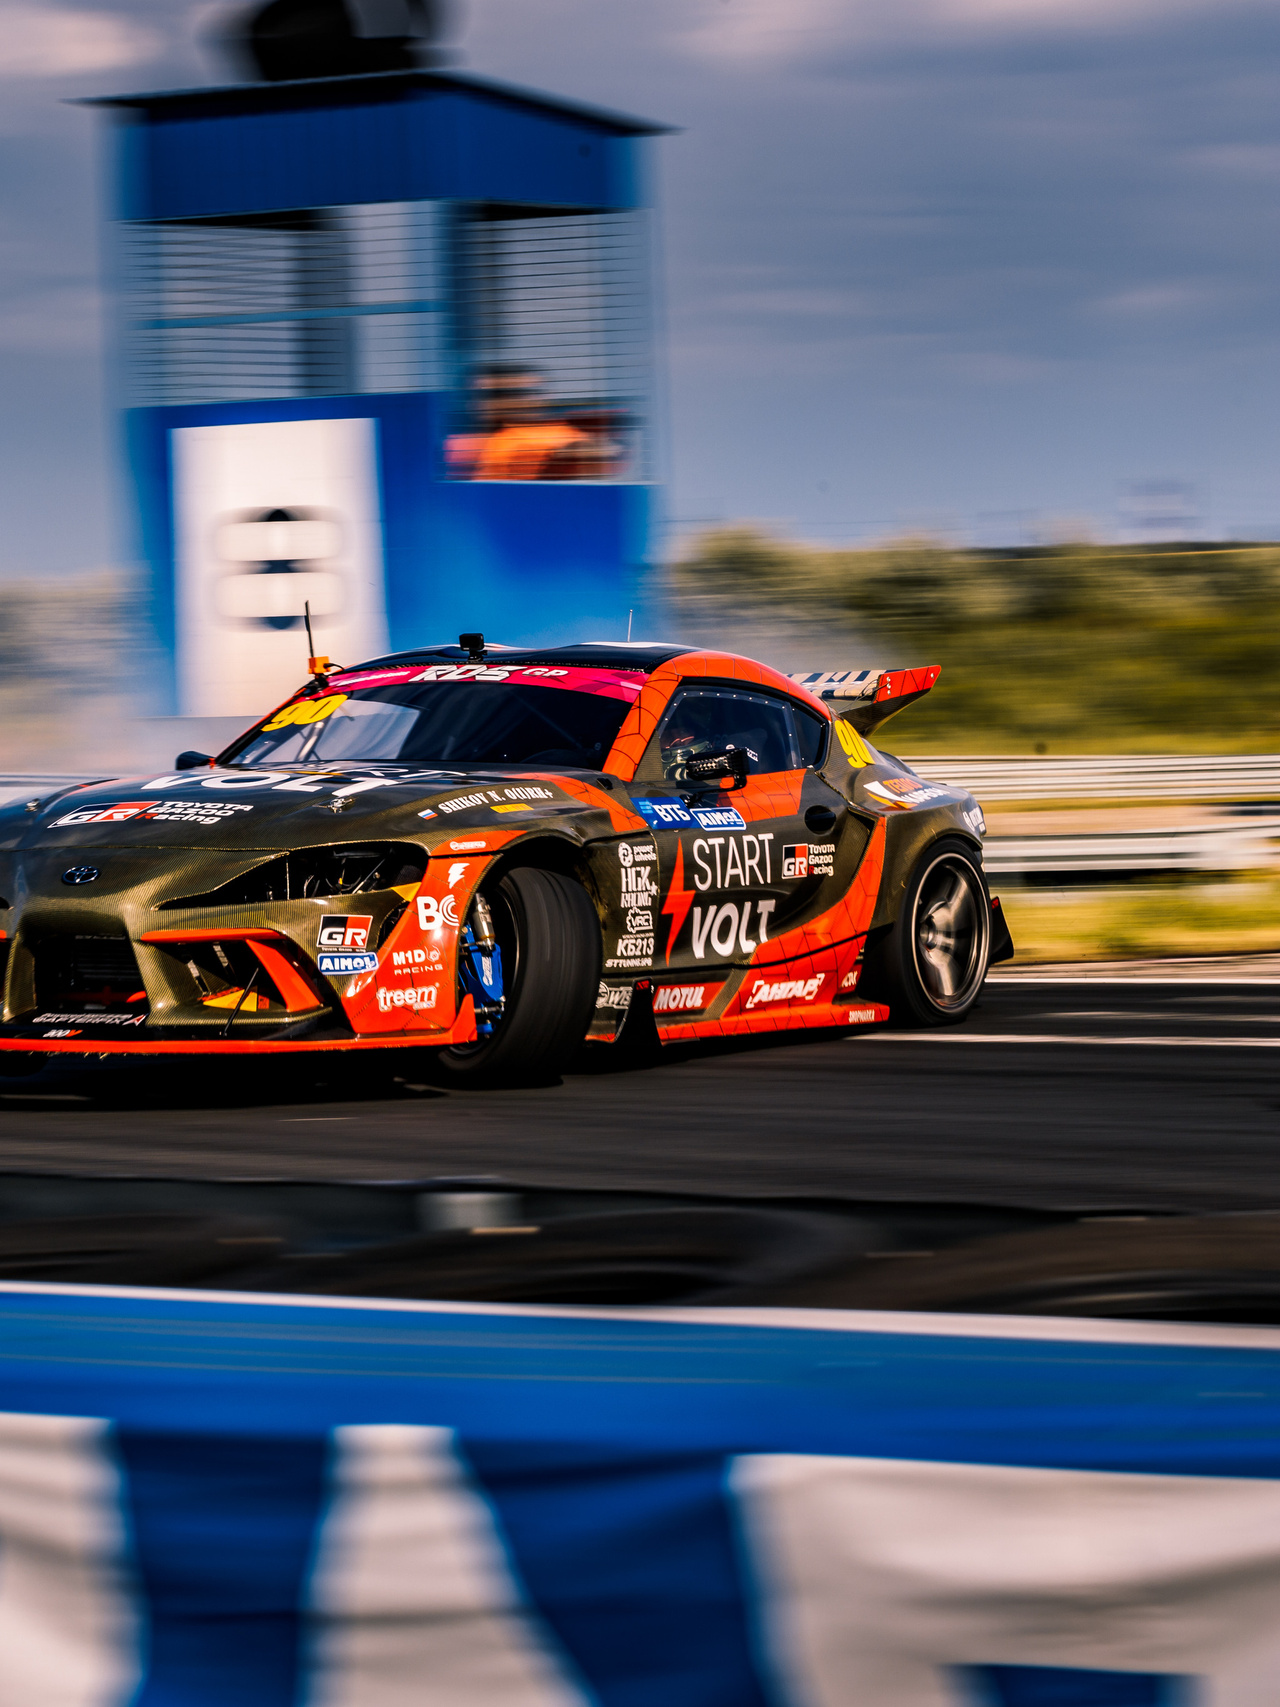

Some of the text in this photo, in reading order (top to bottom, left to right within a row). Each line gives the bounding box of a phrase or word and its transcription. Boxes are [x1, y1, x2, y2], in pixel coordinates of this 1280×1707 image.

[409, 665, 527, 682] RDS
[522, 667, 569, 679] GP
[261, 694, 349, 732] 90
[835, 719, 876, 768] 90
[141, 773, 401, 797] VOLT
[163, 801, 253, 811] TOYOTA
[438, 792, 489, 814] SHIKOV
[487, 790, 506, 802] N.
[57, 809, 140, 826] GR
[135, 813, 221, 825] Racing
[147, 808, 235, 816] GAZOO
[653, 804, 691, 822] ВТБ
[809, 844, 836, 854] TOYOTA
[692, 833, 775, 891] START
[783, 857, 807, 877] GR
[809, 854, 833, 865] GAZOO
[809, 864, 834, 877] Racing
[320, 927, 368, 946] GR
[691, 899, 776, 960] VOLT
[321, 956, 376, 971] AIMOL
[394, 964, 444, 976] RACING
[376, 985, 438, 1012] freem
[654, 986, 705, 1010] MOTUL
